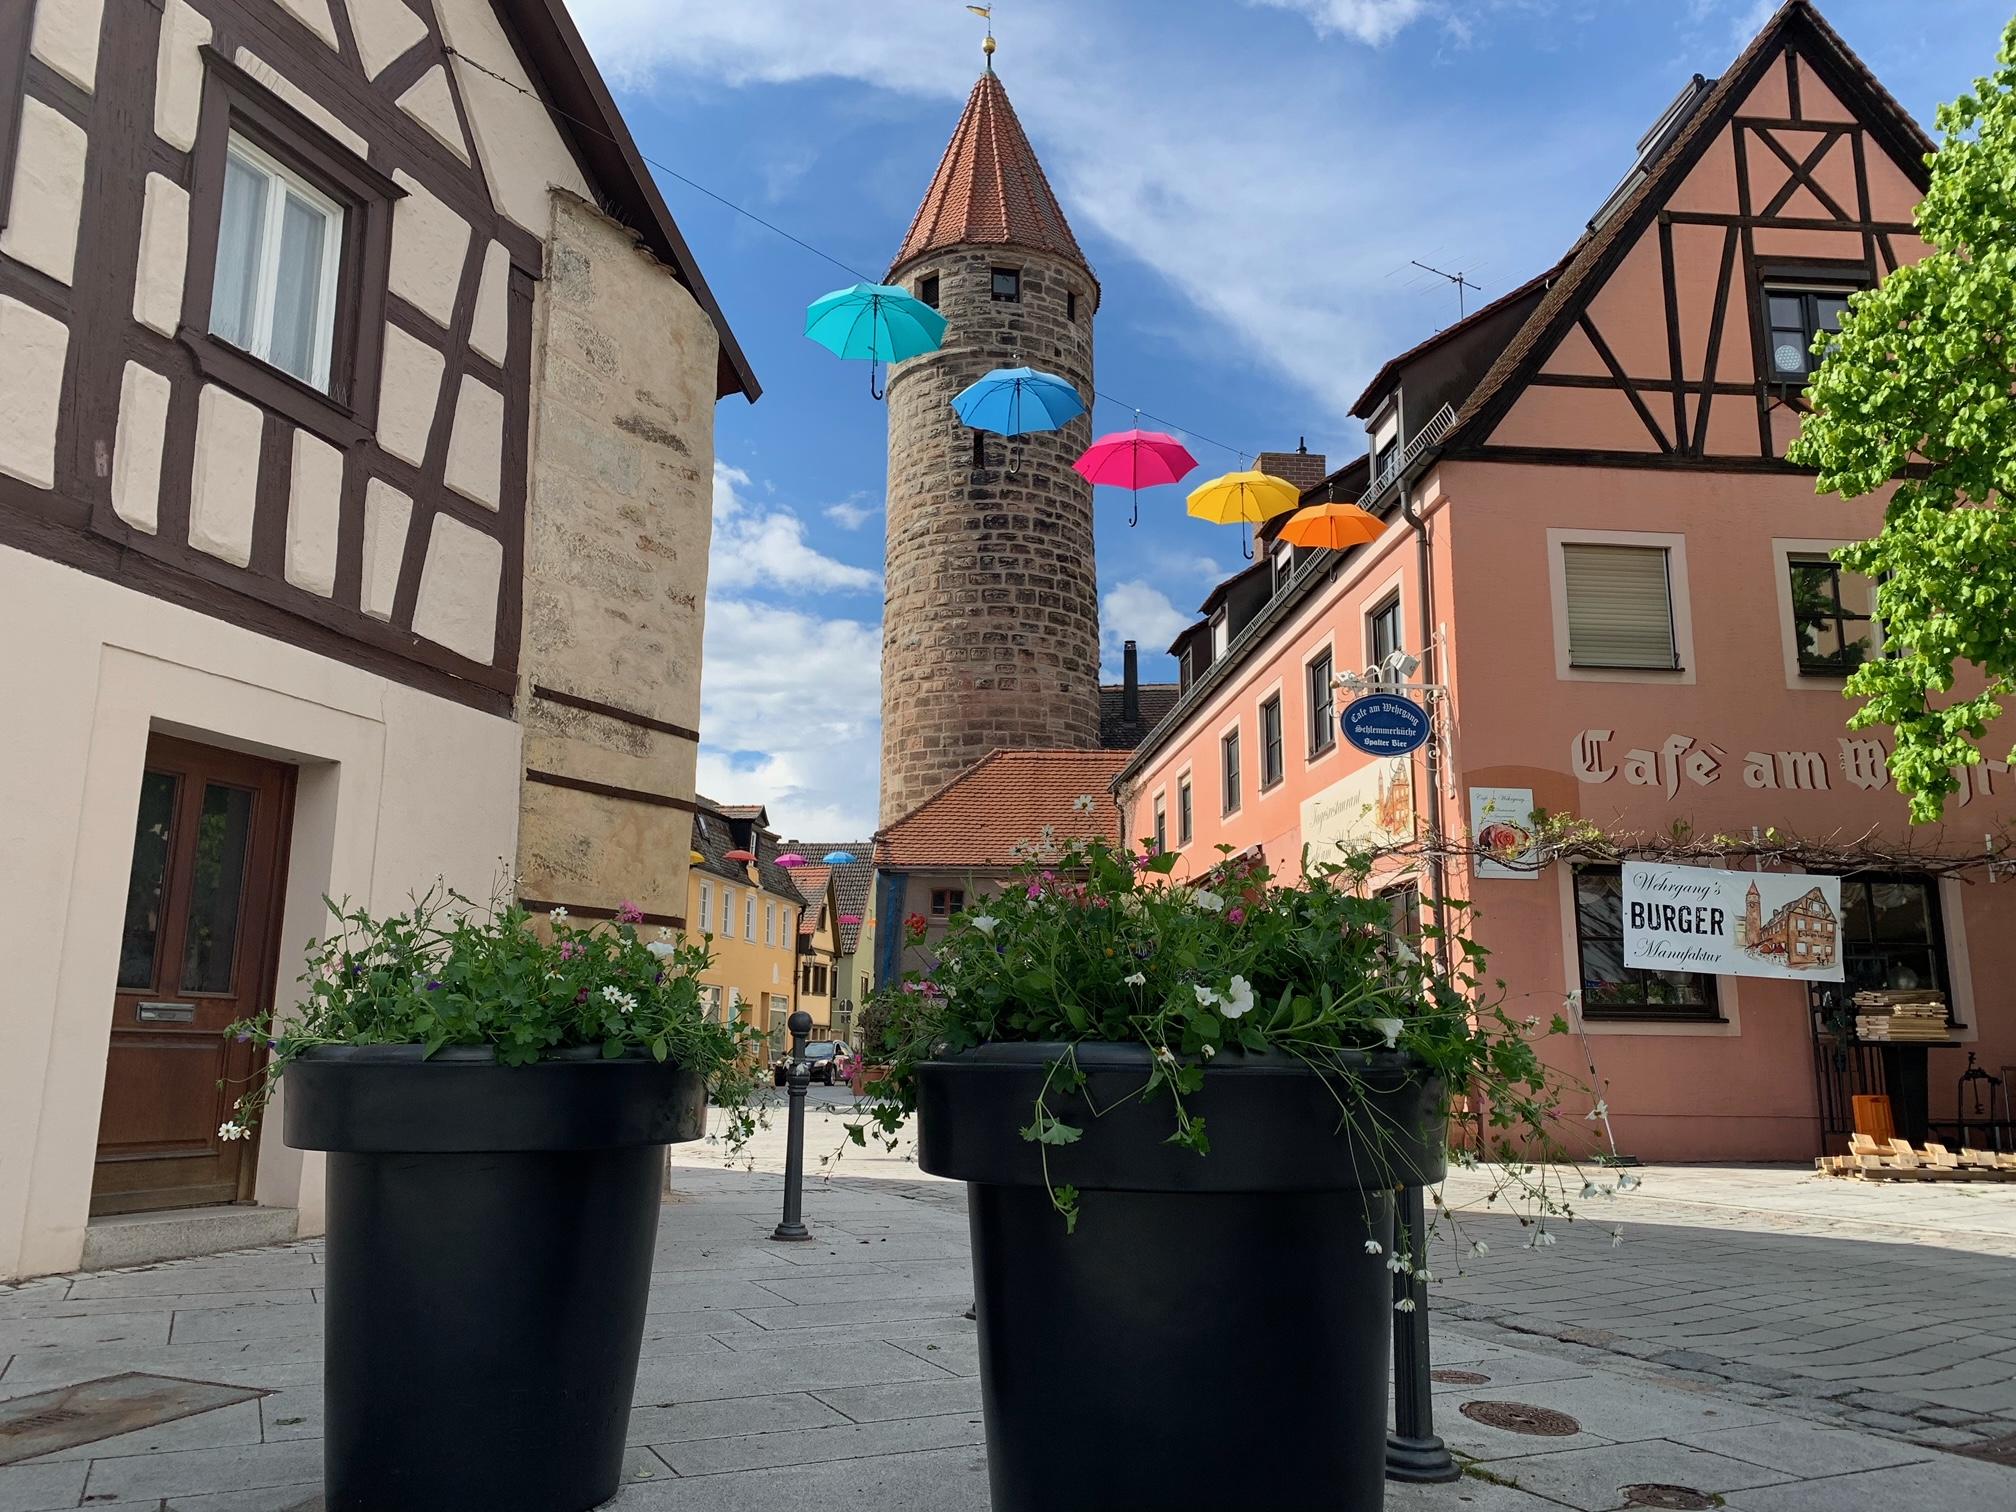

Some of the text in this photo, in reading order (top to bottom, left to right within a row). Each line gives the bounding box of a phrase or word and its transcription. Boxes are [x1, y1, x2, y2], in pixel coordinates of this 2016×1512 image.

[1382, 702, 1419, 726] Wehrgang
[1355, 725, 1416, 736] Schlemmerküche
[1364, 737, 1407, 747] Spalter Bier
[1743, 751, 1832, 790] am
[1633, 870, 1722, 901] Wehrgang's
[1630, 901, 1725, 936] BURGER
[1634, 937, 1722, 966] Manufaktur
